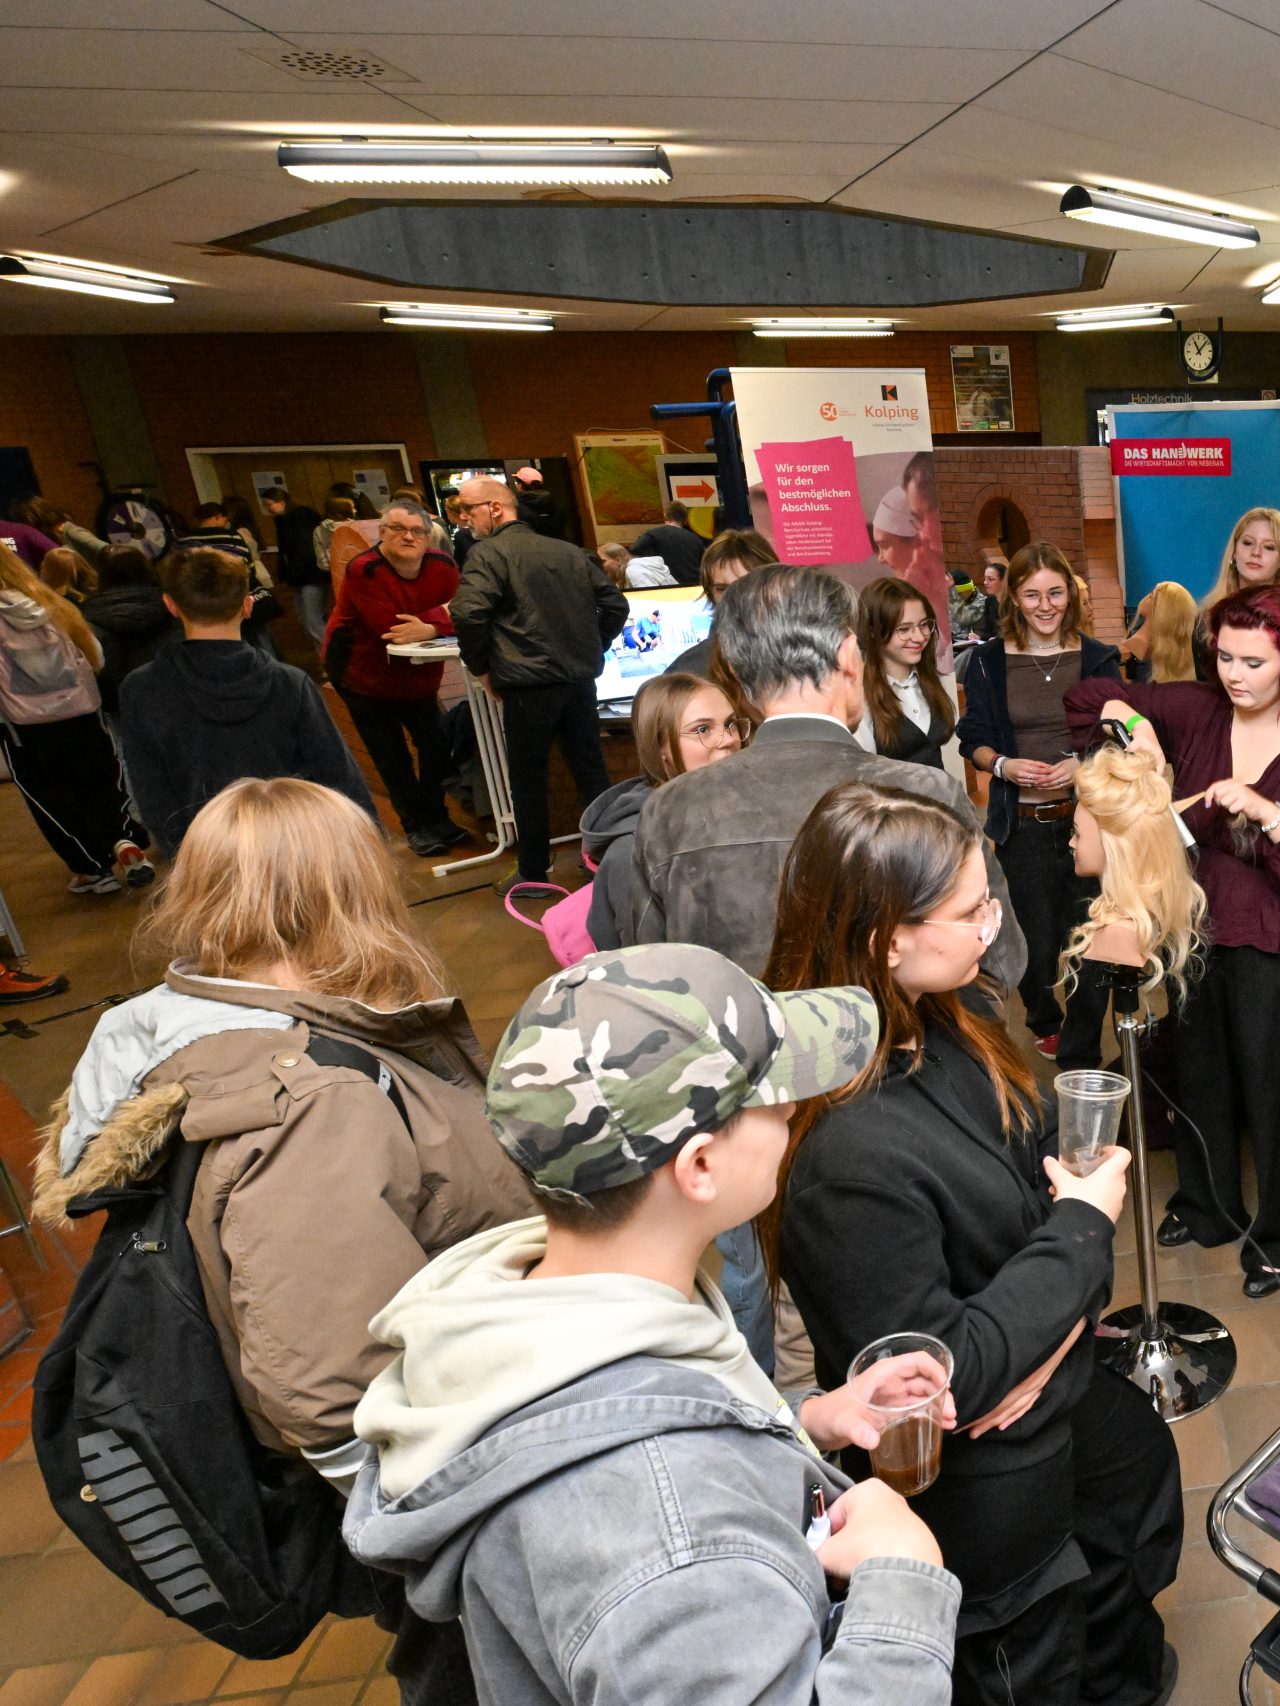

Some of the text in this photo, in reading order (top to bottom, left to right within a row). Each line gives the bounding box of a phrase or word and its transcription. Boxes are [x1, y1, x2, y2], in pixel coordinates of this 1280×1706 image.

[1131, 392, 1193, 403] Holztechnik
[864, 405, 919, 421] Kolping
[1124, 442, 1223, 459] DAS HANDWERK
[775, 464, 830, 474] Wir sorgen
[777, 476, 814, 486] für den
[779, 489, 851, 500] bestmöglichen
[781, 502, 832, 512] Abschluss.
